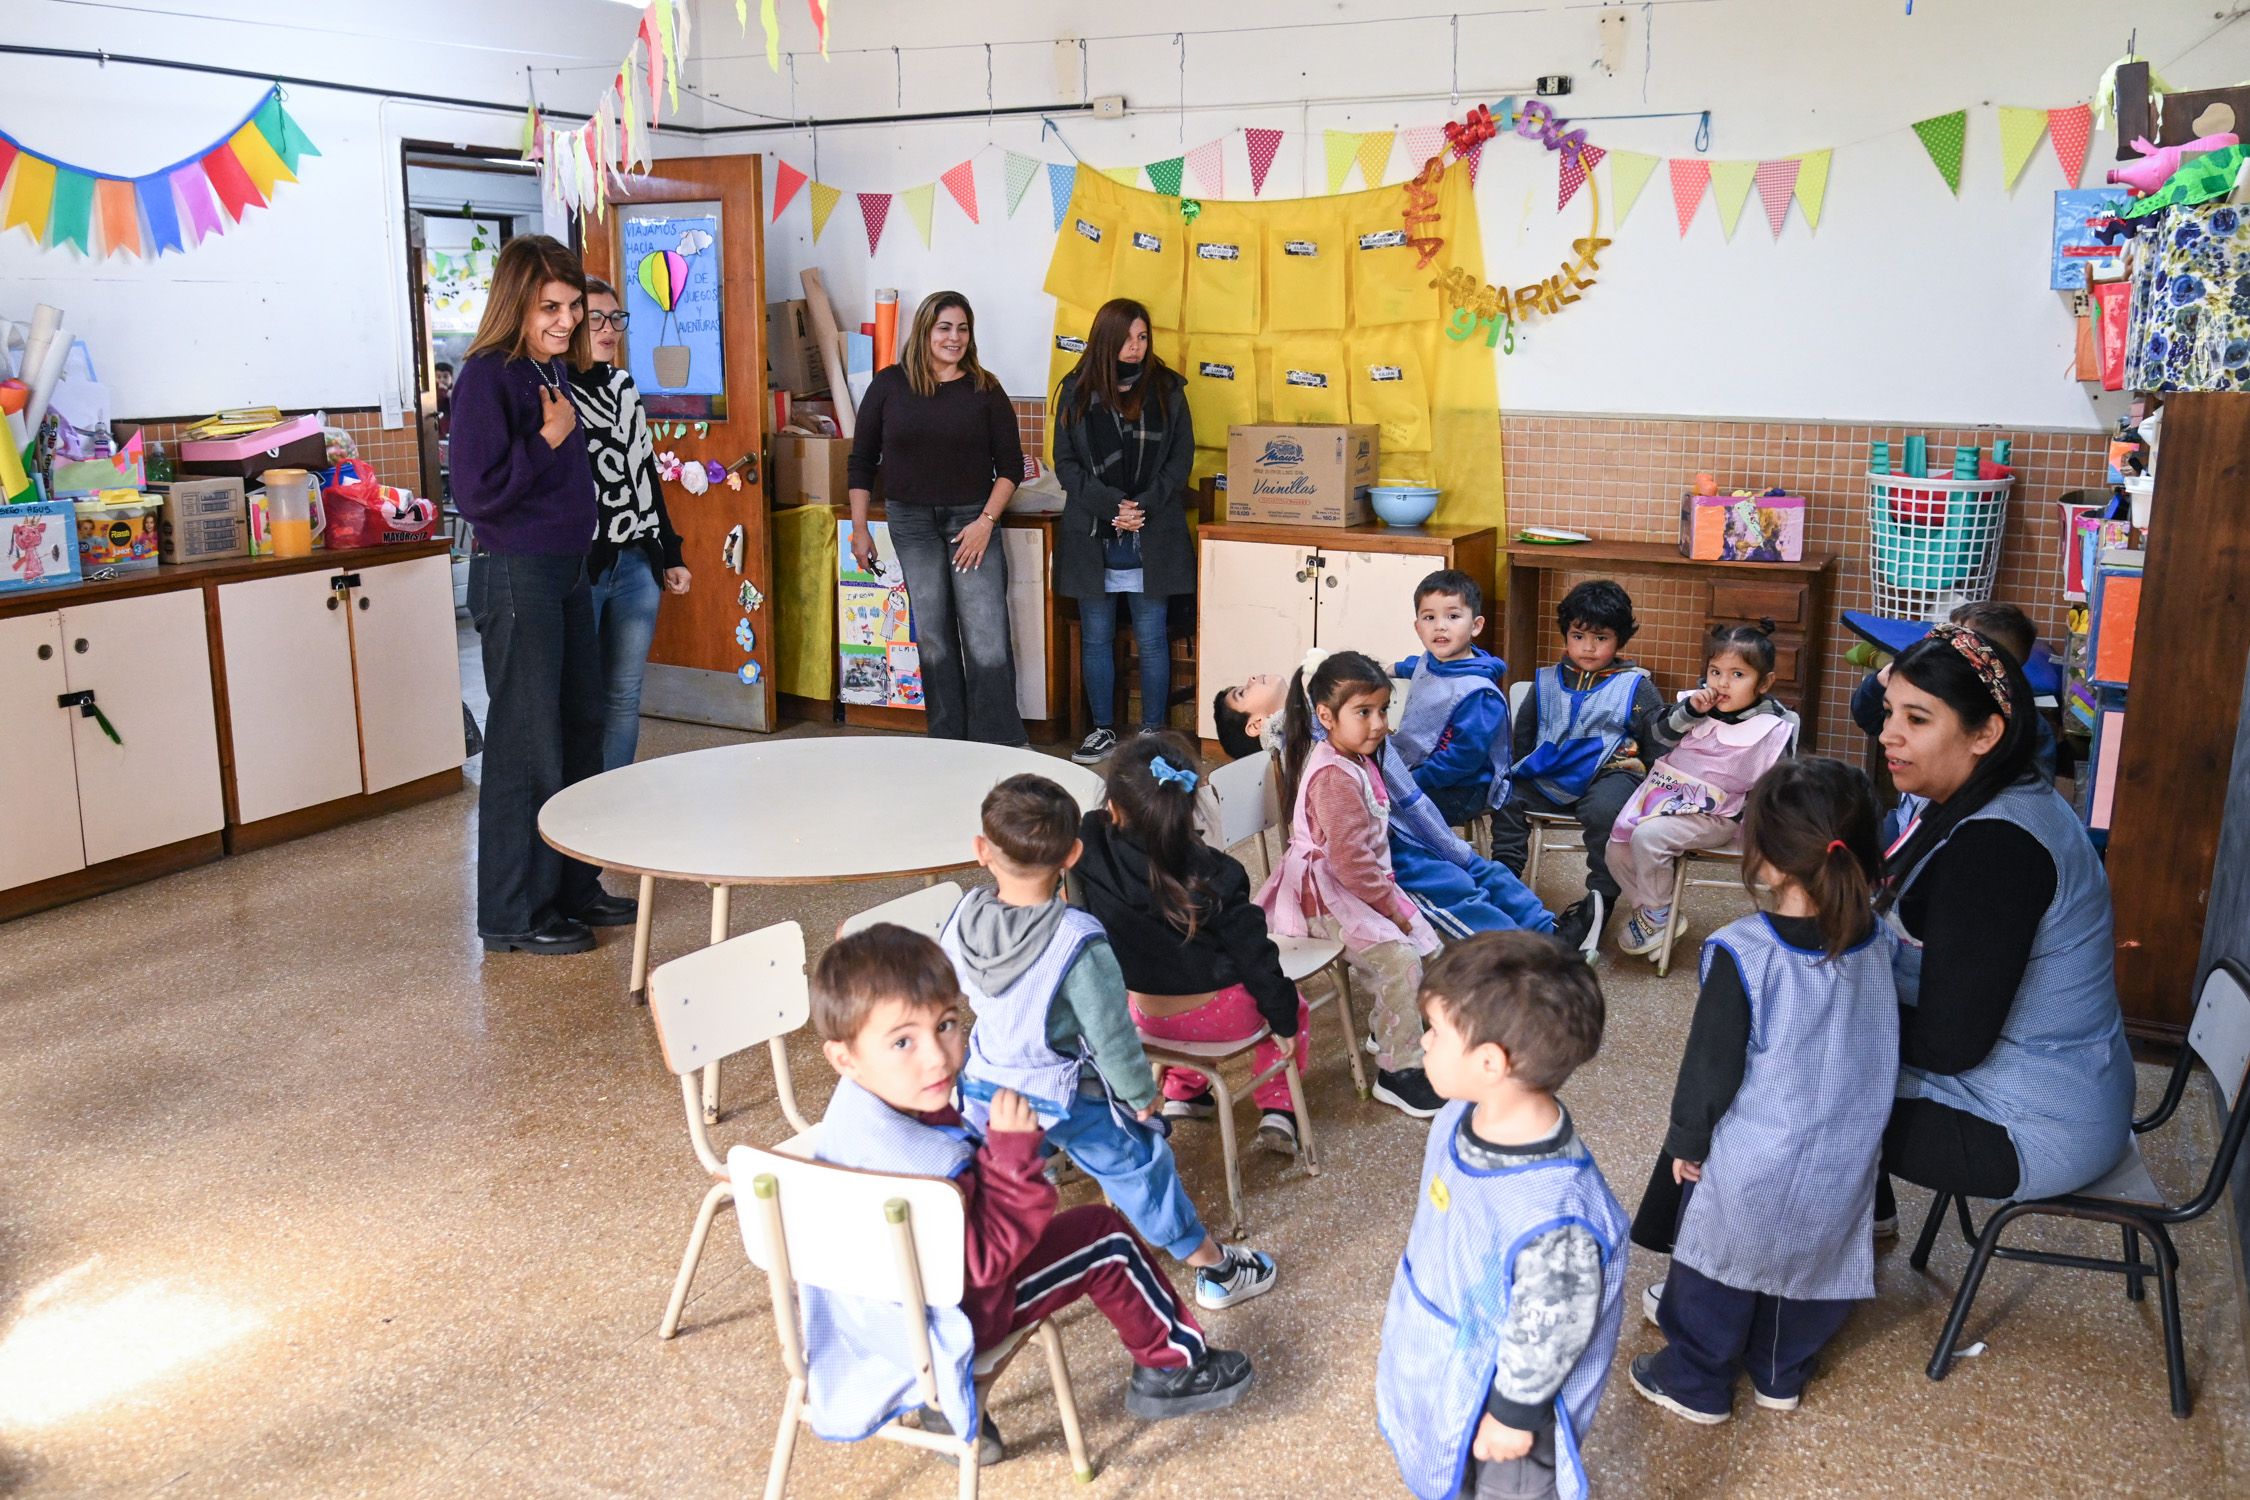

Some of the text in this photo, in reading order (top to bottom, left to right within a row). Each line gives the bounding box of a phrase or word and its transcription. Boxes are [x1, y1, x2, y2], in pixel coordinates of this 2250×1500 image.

[625, 223, 677, 237] VIAJAMOS
[626, 271, 640, 286] AÑ
[694, 272, 709, 284] DE
[683, 288, 719, 304] JUEGOS
[696, 304, 702, 318] Y
[678, 319, 720, 333] AVENTURAS
[1252, 475, 1318, 495] Vainillas
